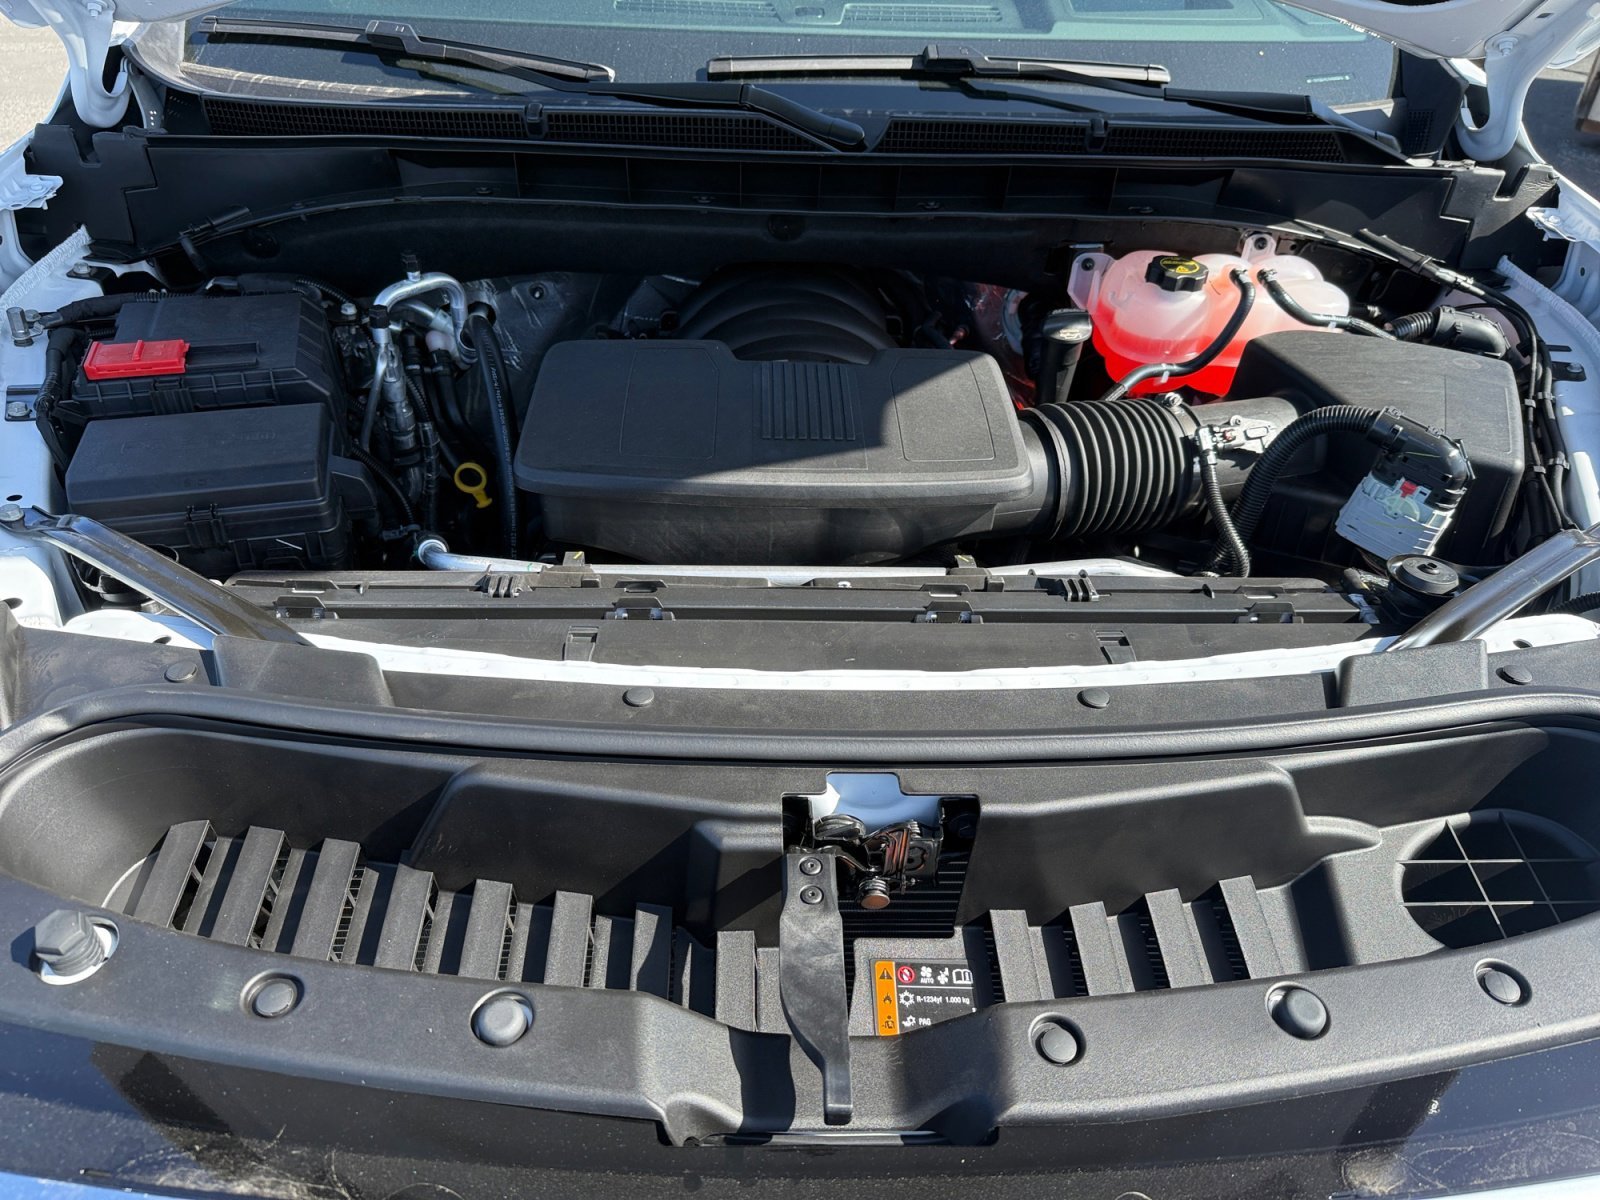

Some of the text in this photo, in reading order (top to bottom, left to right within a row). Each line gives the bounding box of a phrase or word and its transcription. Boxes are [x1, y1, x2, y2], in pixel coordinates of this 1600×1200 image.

[916, 995, 970, 1005] R-1234yf 1.000 kg
[918, 1017, 932, 1026] PAG
